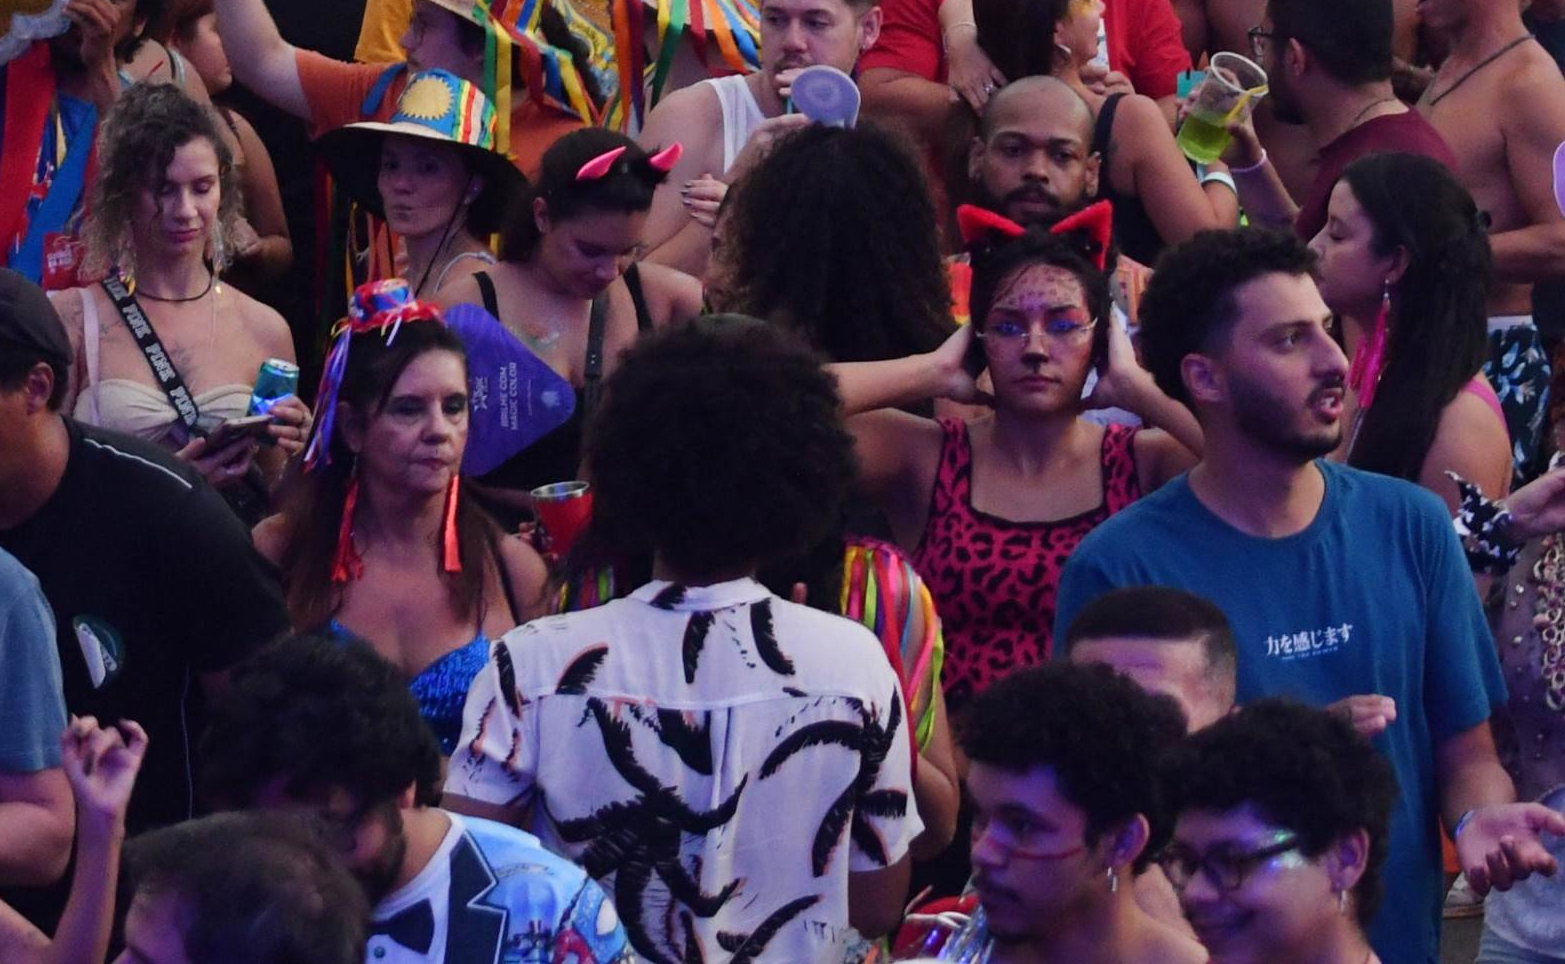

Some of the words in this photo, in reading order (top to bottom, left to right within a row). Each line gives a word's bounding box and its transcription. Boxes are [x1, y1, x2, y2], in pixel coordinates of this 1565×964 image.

[122, 304, 152, 339] PINK
[145, 344, 177, 383] PINK
[509, 362, 518, 397] COLOR
[1263, 622, 1354, 656] 力を感じます
